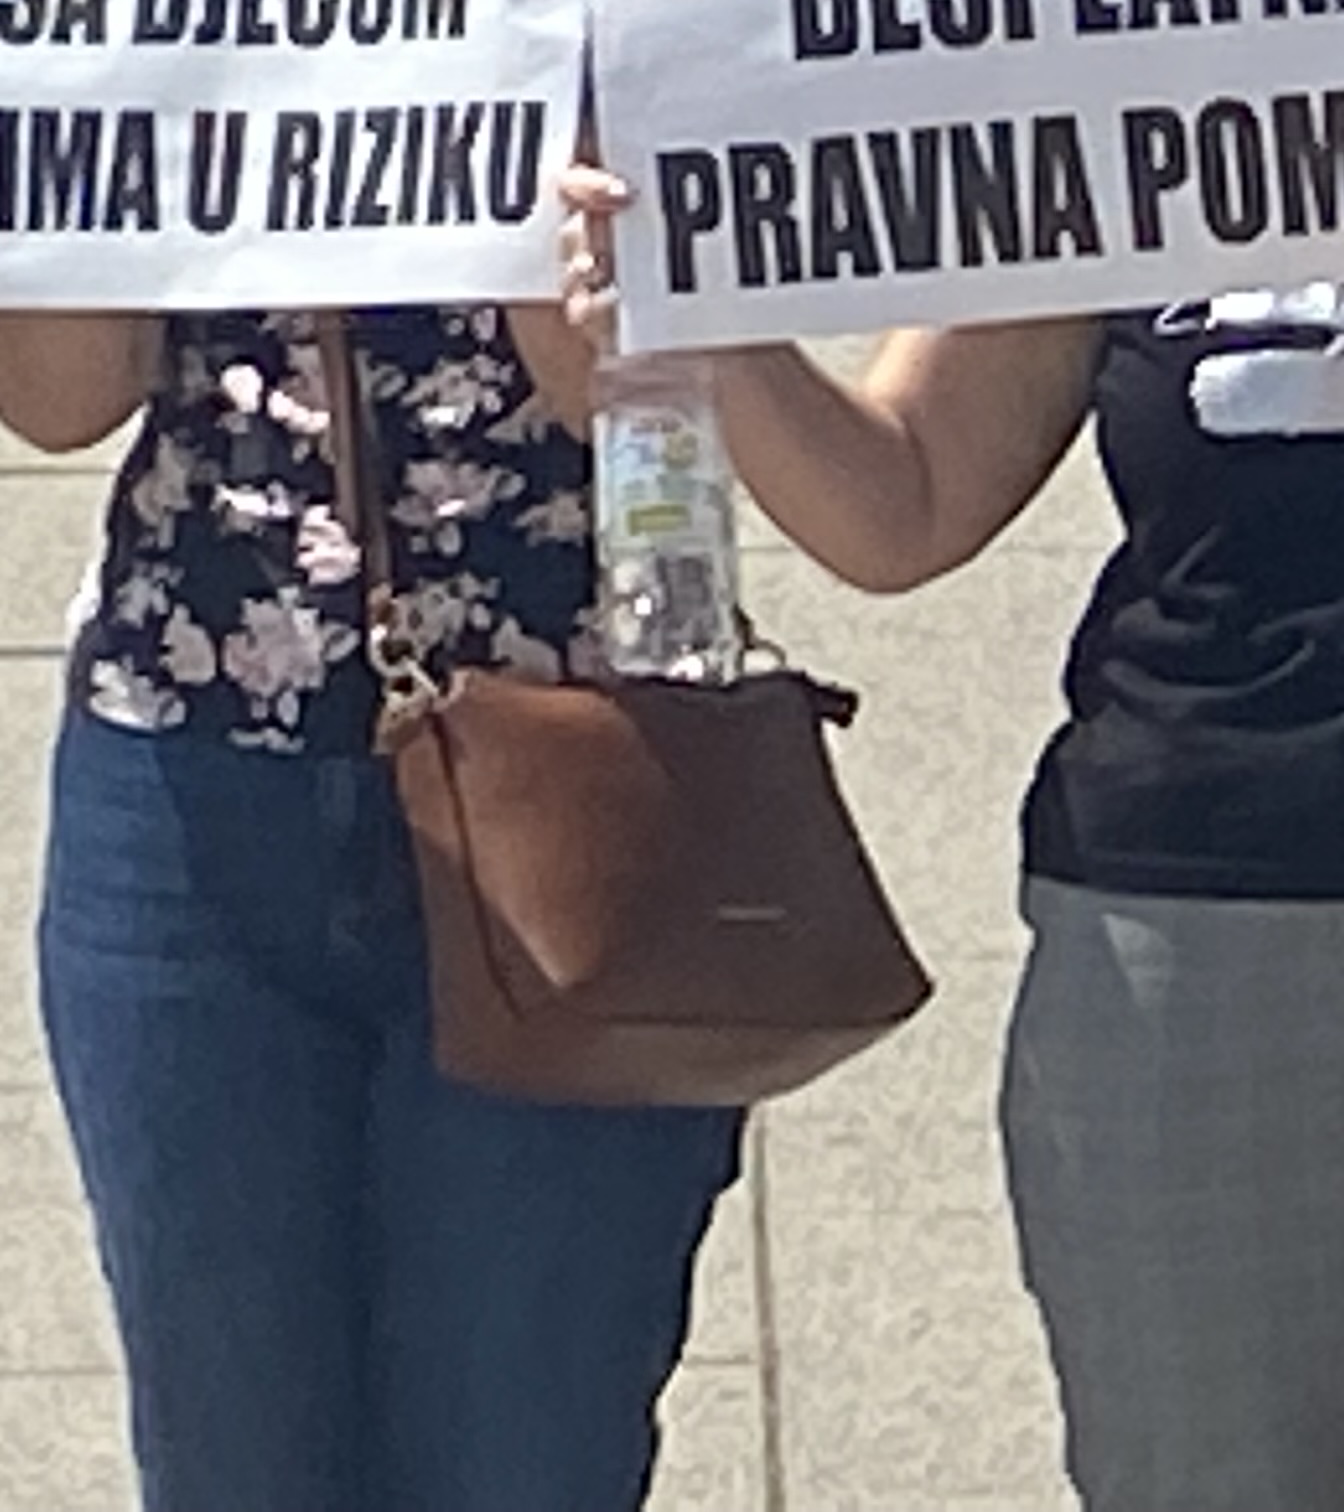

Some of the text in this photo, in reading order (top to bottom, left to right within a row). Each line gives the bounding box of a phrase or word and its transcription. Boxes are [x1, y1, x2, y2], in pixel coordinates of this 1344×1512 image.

[188, 110, 247, 235] U
[267, 101, 546, 232] RIZIKU
[654, 114, 1105, 296] PRAVNA
